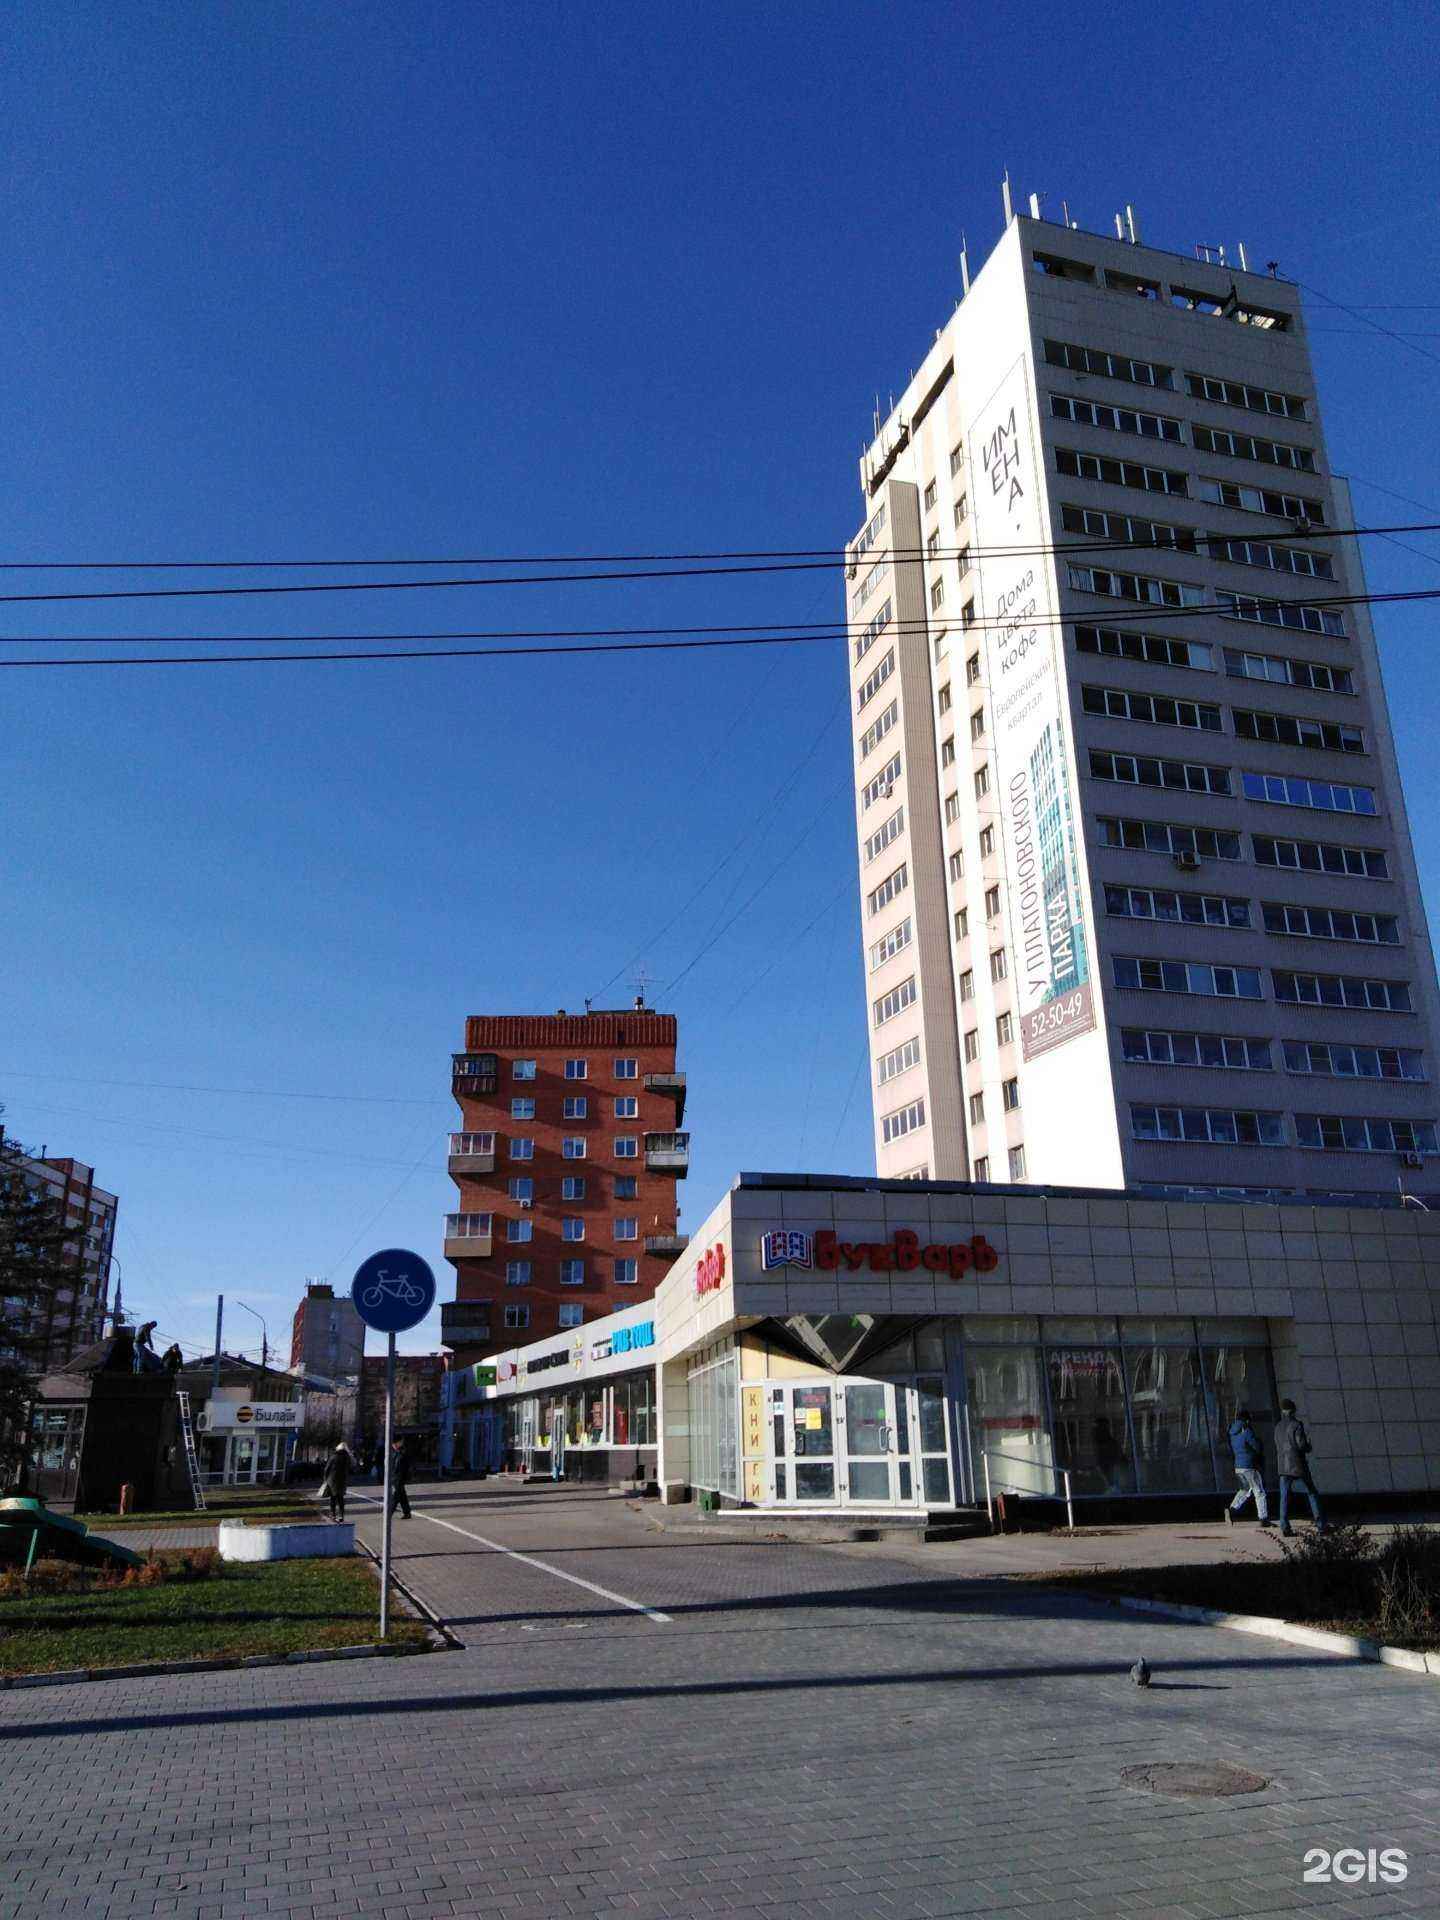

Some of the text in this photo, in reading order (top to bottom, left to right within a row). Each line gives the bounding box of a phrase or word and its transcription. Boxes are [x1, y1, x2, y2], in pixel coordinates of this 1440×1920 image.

[996, 569, 1034, 624] Дома
[997, 598, 1037, 648] цвета
[1000, 628, 1037, 674] кофе
[1009, 771, 1045, 972] ПЛАТОНОВСКОГО
[1047, 889, 1075, 980] ПАРКА
[1031, 992, 1082, 1038] 52-50-49
